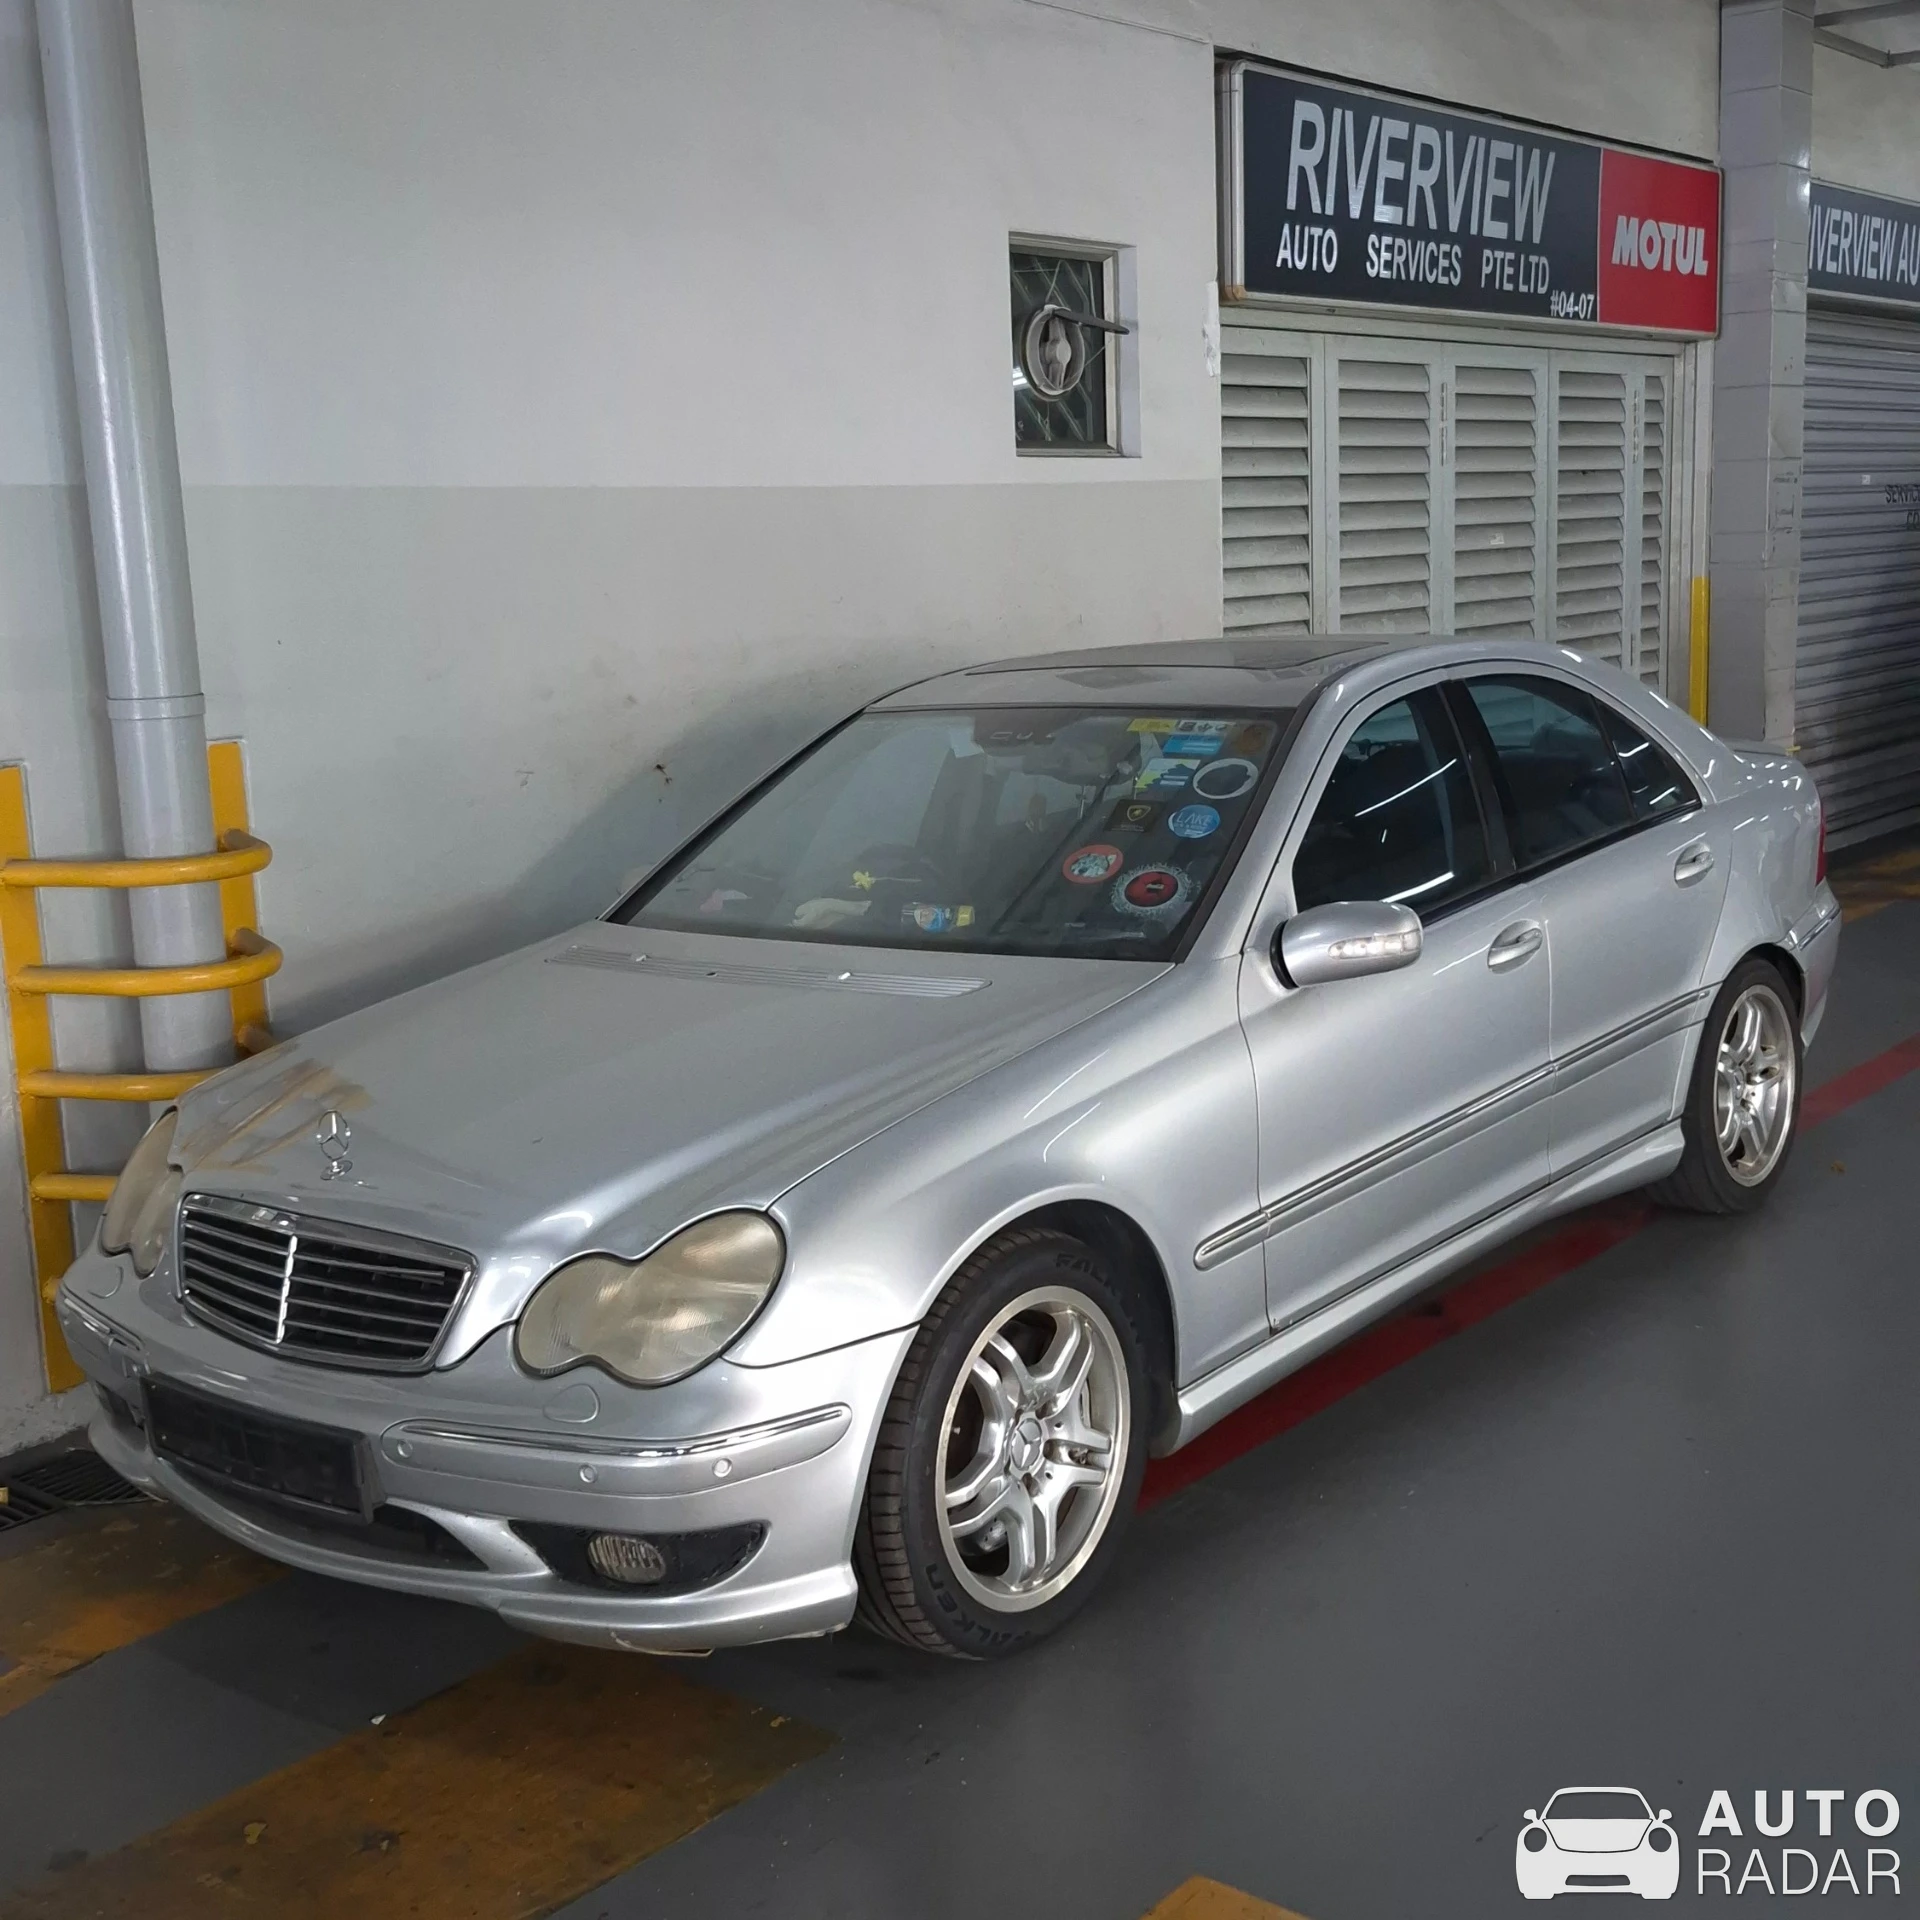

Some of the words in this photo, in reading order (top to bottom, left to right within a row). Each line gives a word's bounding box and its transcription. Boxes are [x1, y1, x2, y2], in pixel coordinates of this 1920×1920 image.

[1286, 99, 1556, 244] RIVERVIEW
[1276, 222, 1338, 273] AUTO
[1366, 233, 1462, 286] SERVICES
[1481, 248, 1515, 291] PTE
[1518, 254, 1550, 294] LTD
[1611, 215, 1708, 276] MOTUL
[1809, 204, 1898, 282] IVERVIEW
[1550, 289, 1595, 319] #04-07
[1175, 811, 1213, 827] LAKE
